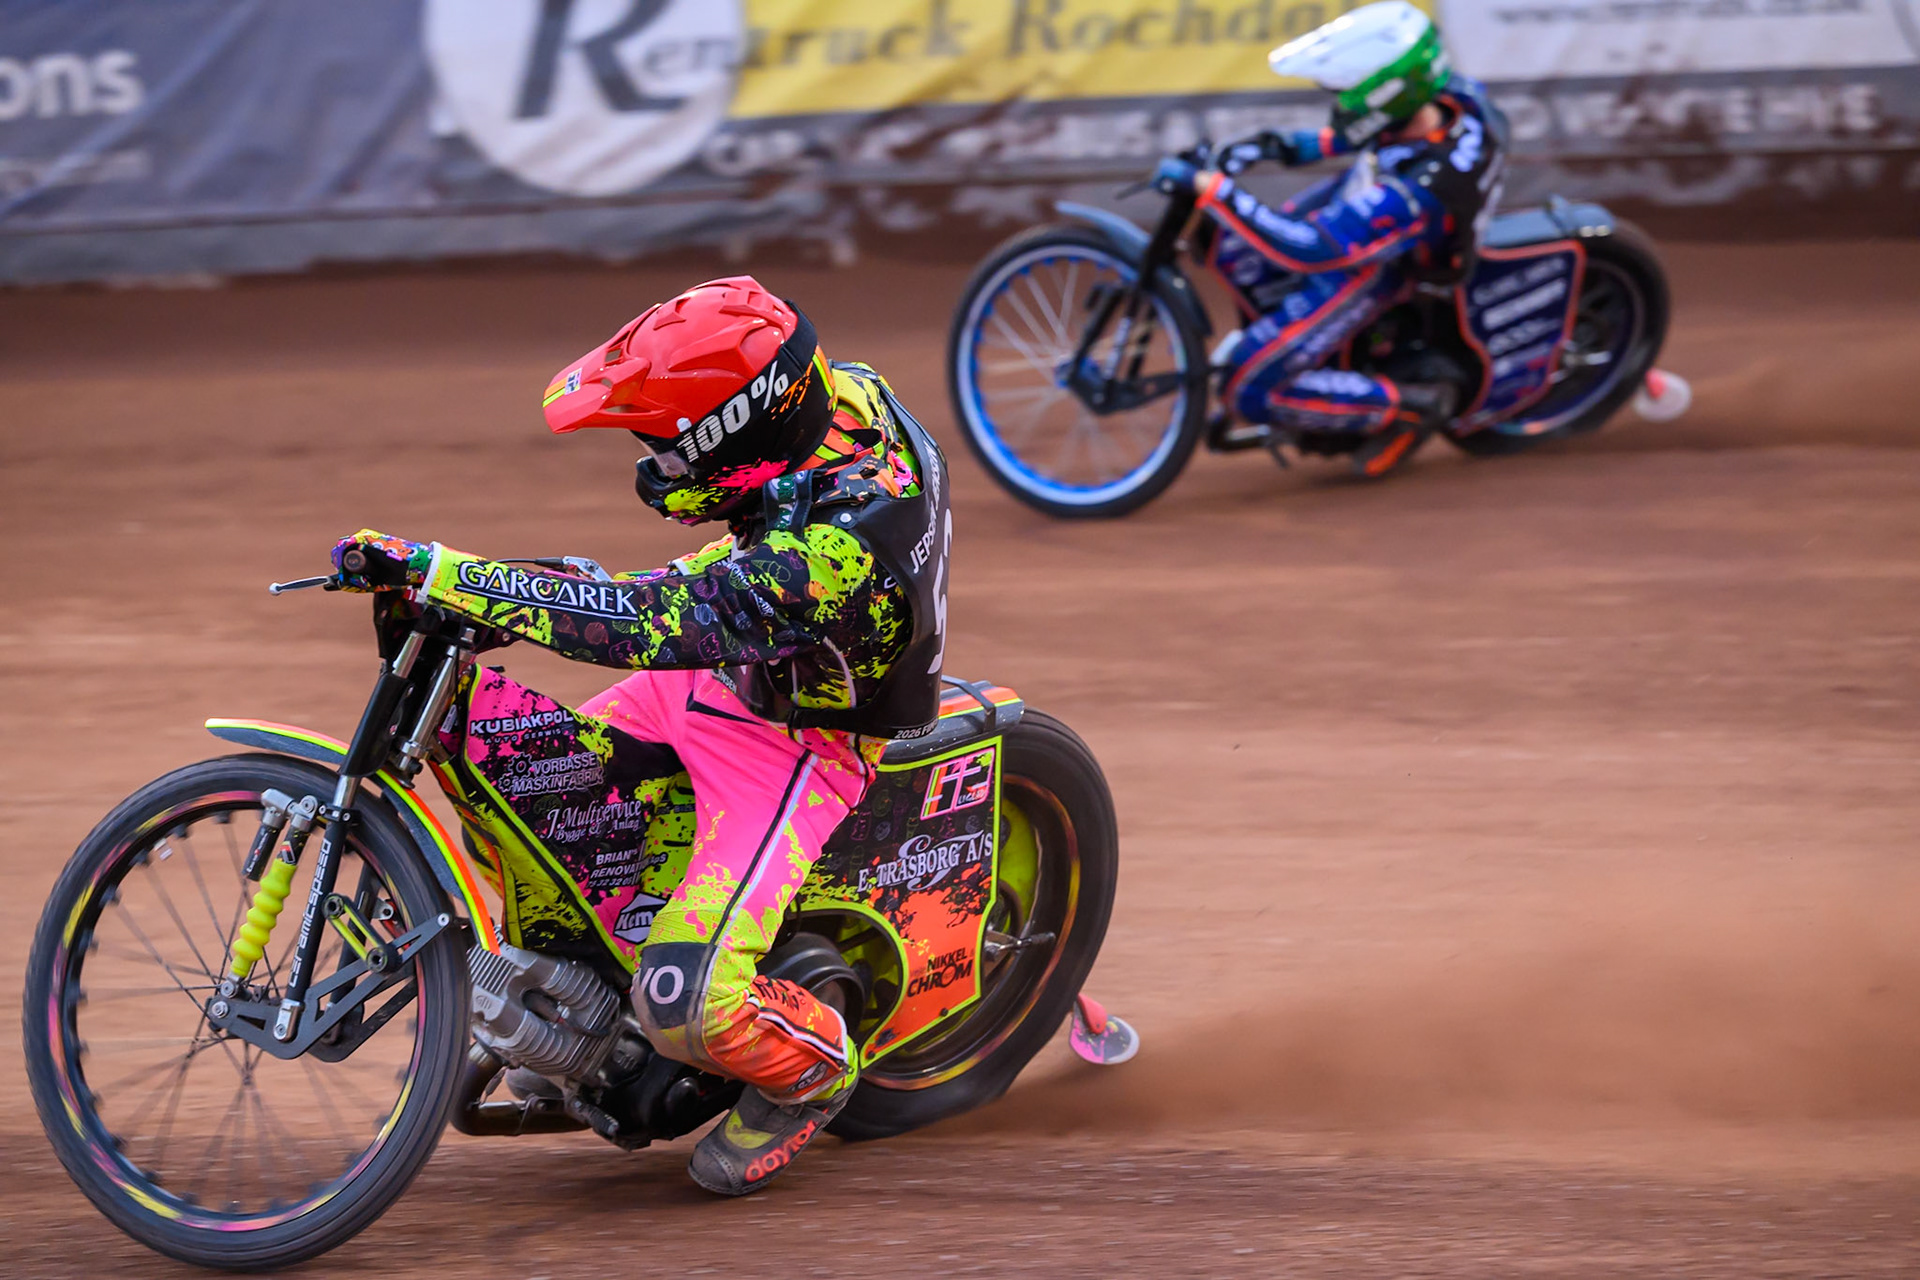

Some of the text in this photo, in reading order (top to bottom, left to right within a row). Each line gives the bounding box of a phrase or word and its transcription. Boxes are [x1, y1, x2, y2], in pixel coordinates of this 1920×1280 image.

[1003, 0, 1348, 54] Rochda
[676, 360, 789, 463] 100%
[458, 561, 638, 615] GARCAREK
[719, 667, 737, 694] ENSEN
[470, 710, 574, 735] KUBIAKPOL
[894, 727, 922, 739] 2026
[486, 728, 562, 745] AUTO SERWIS
[532, 752, 598, 775] VORBASSE
[513, 769, 602, 794] MASKINFABRIK
[555, 828, 587, 844] Bygge
[876, 842, 962, 888] TRASBORG
[966, 832, 993, 863] A/S
[927, 947, 968, 971] NIKKEL
[907, 959, 974, 997] CHROM
